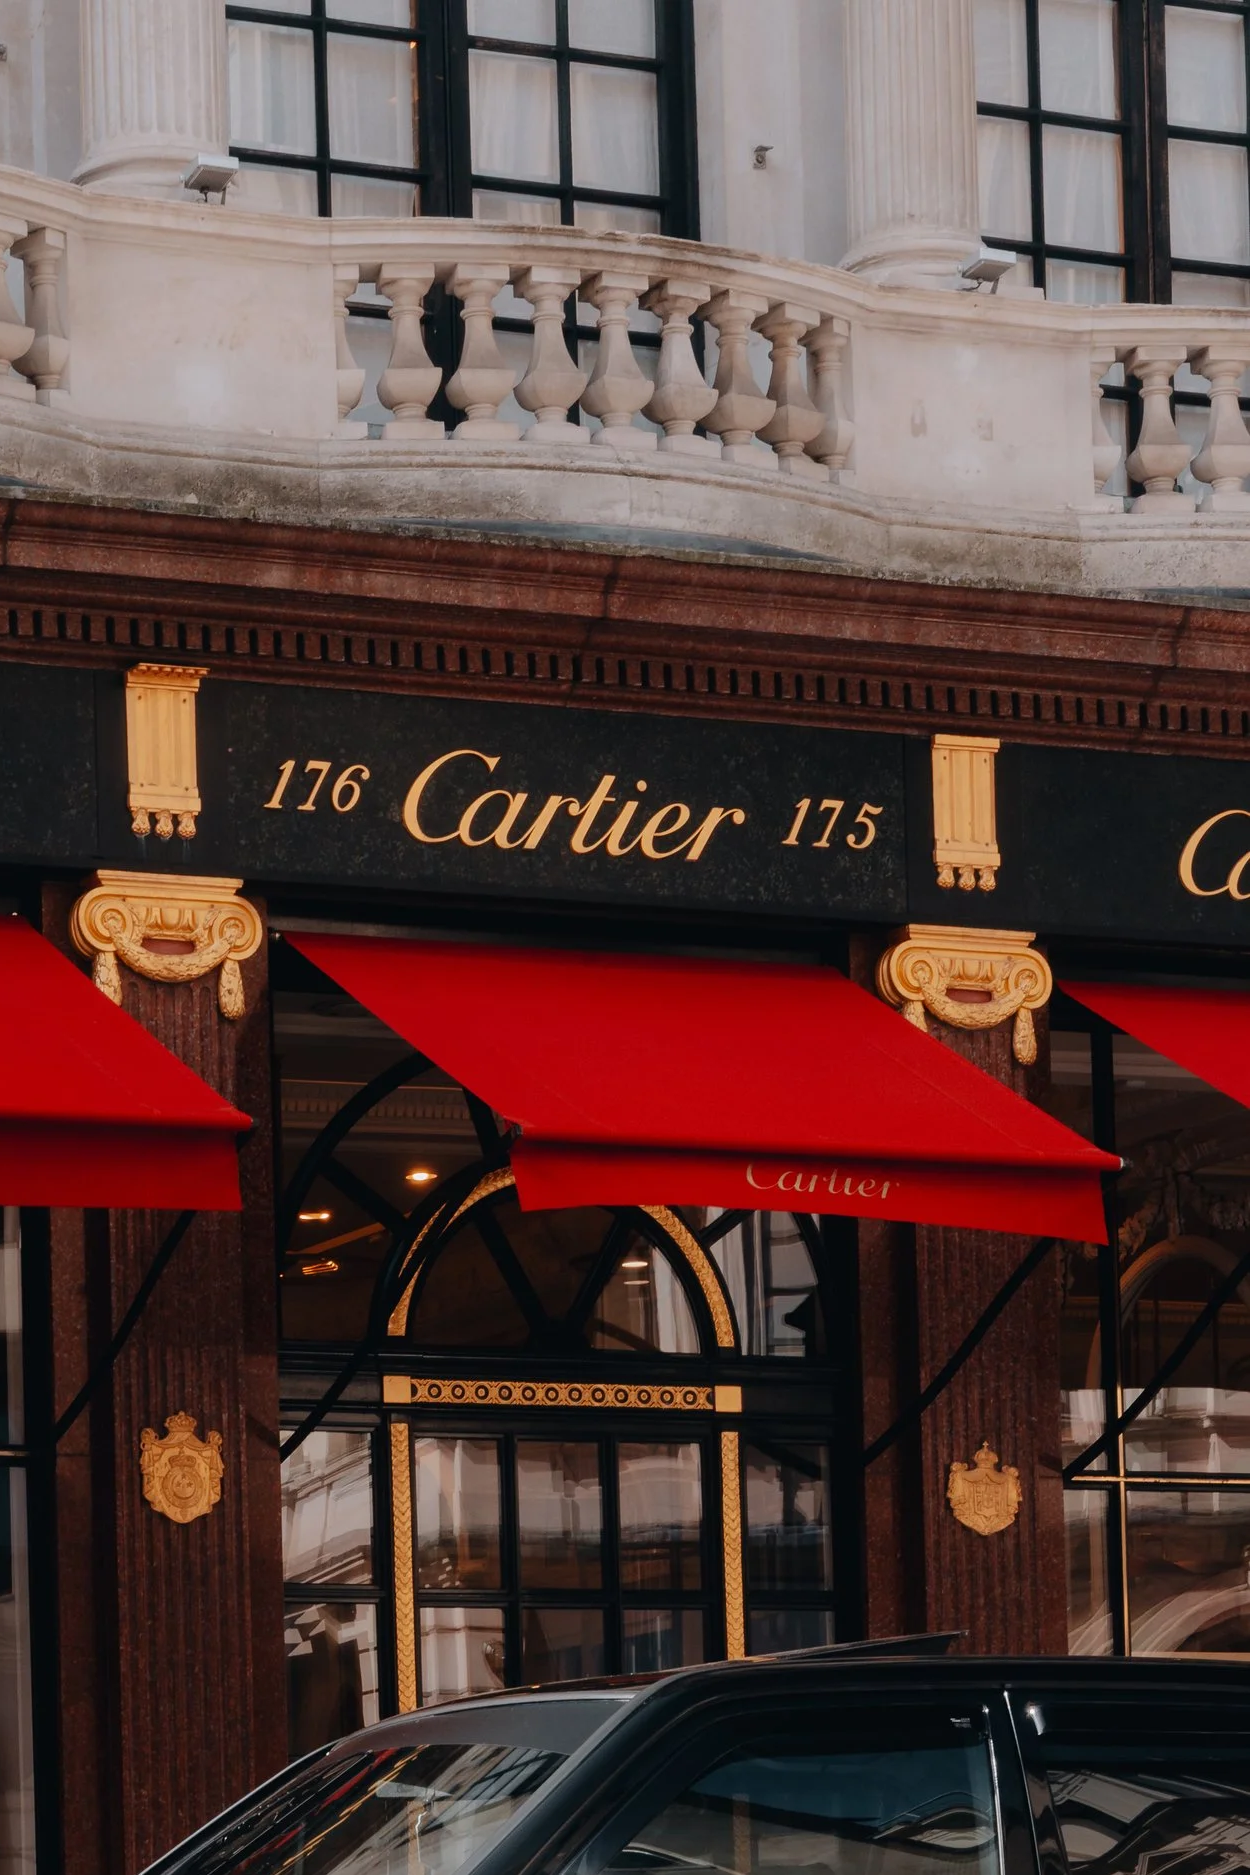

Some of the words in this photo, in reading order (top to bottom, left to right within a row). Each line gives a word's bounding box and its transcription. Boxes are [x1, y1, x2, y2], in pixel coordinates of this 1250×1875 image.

[262, 759, 371, 813] 176
[403, 749, 746, 862] Cartier
[781, 797, 884, 849] 175
